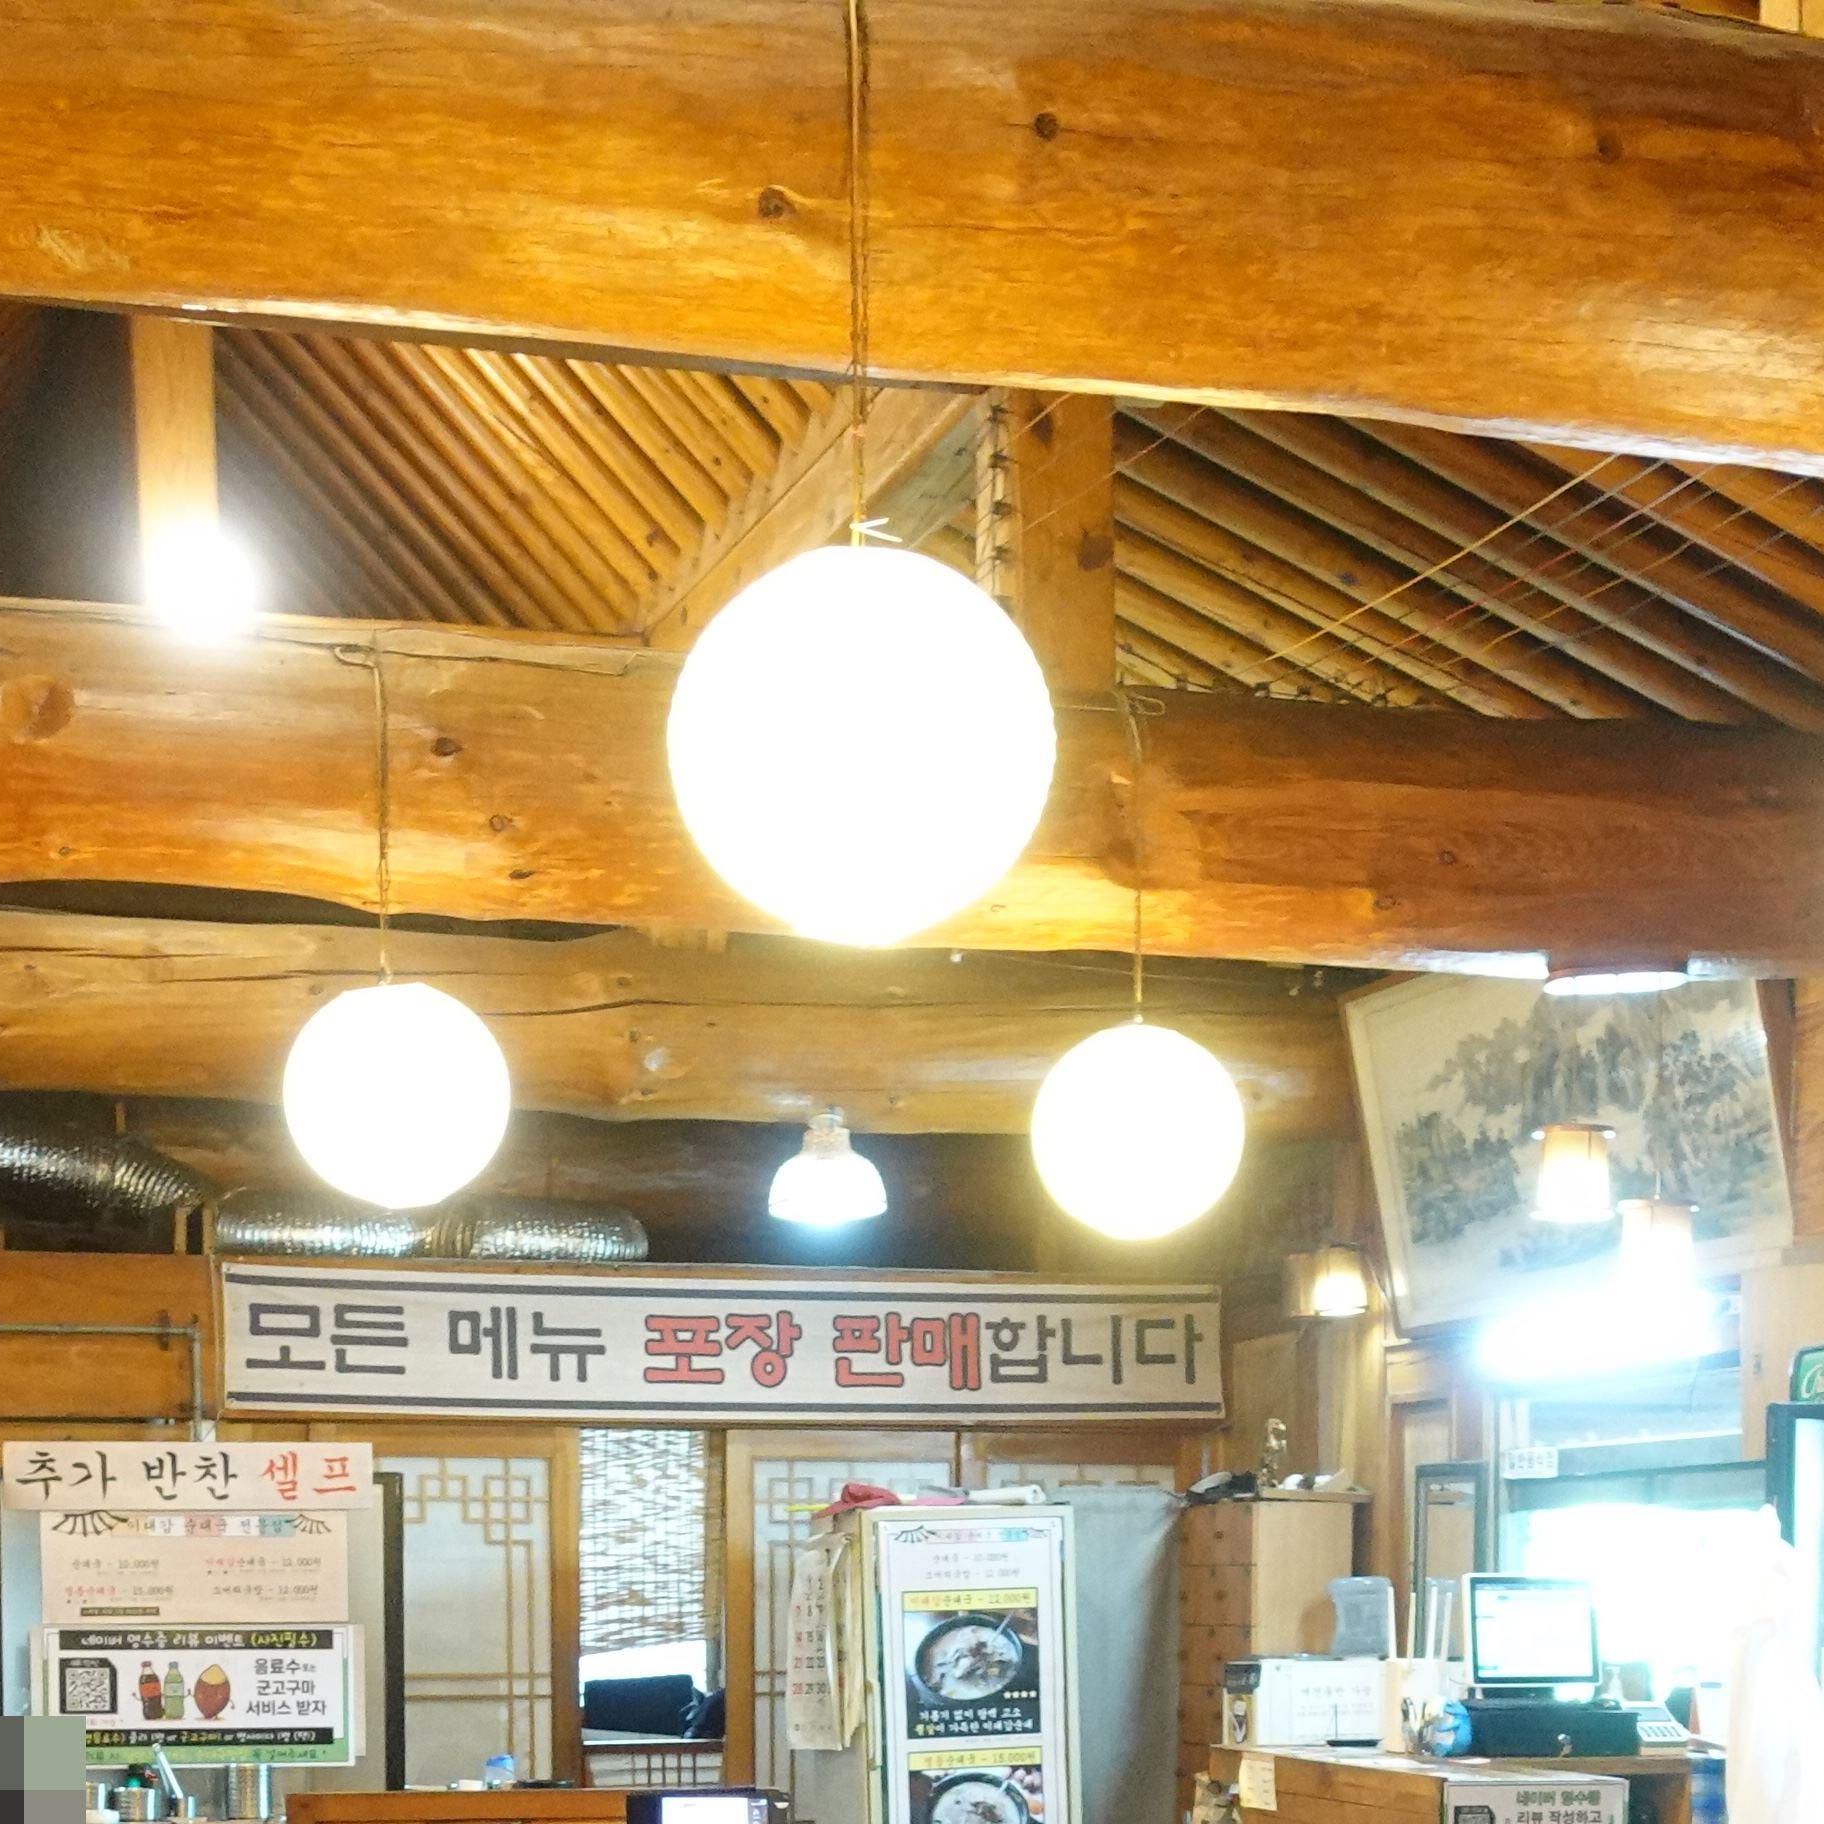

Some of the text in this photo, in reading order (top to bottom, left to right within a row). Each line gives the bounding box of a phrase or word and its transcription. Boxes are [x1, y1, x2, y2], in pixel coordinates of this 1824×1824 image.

[245, 1302, 1205, 1390] 모든 메뉴 포장 판매합니다
[15, 1451, 359, 1502] 추가 반찬 셀프
[184, 1519, 229, 1534] 순대국
[81, 1635, 122, 1646] 네이버
[127, 1633, 168, 1648] 영수증
[173, 1633, 200, 1648] 리뷰
[204, 1634, 245, 1648] 이벤트
[253, 1659, 302, 1675] 음료수
[257, 1680, 316, 1697] 군고구마
[246, 1699, 327, 1717] 서비스 받자
[1516, 1791, 1557, 1806] 네이버
[1516, 1810, 1603, 1824] 리뷰 작성하고
